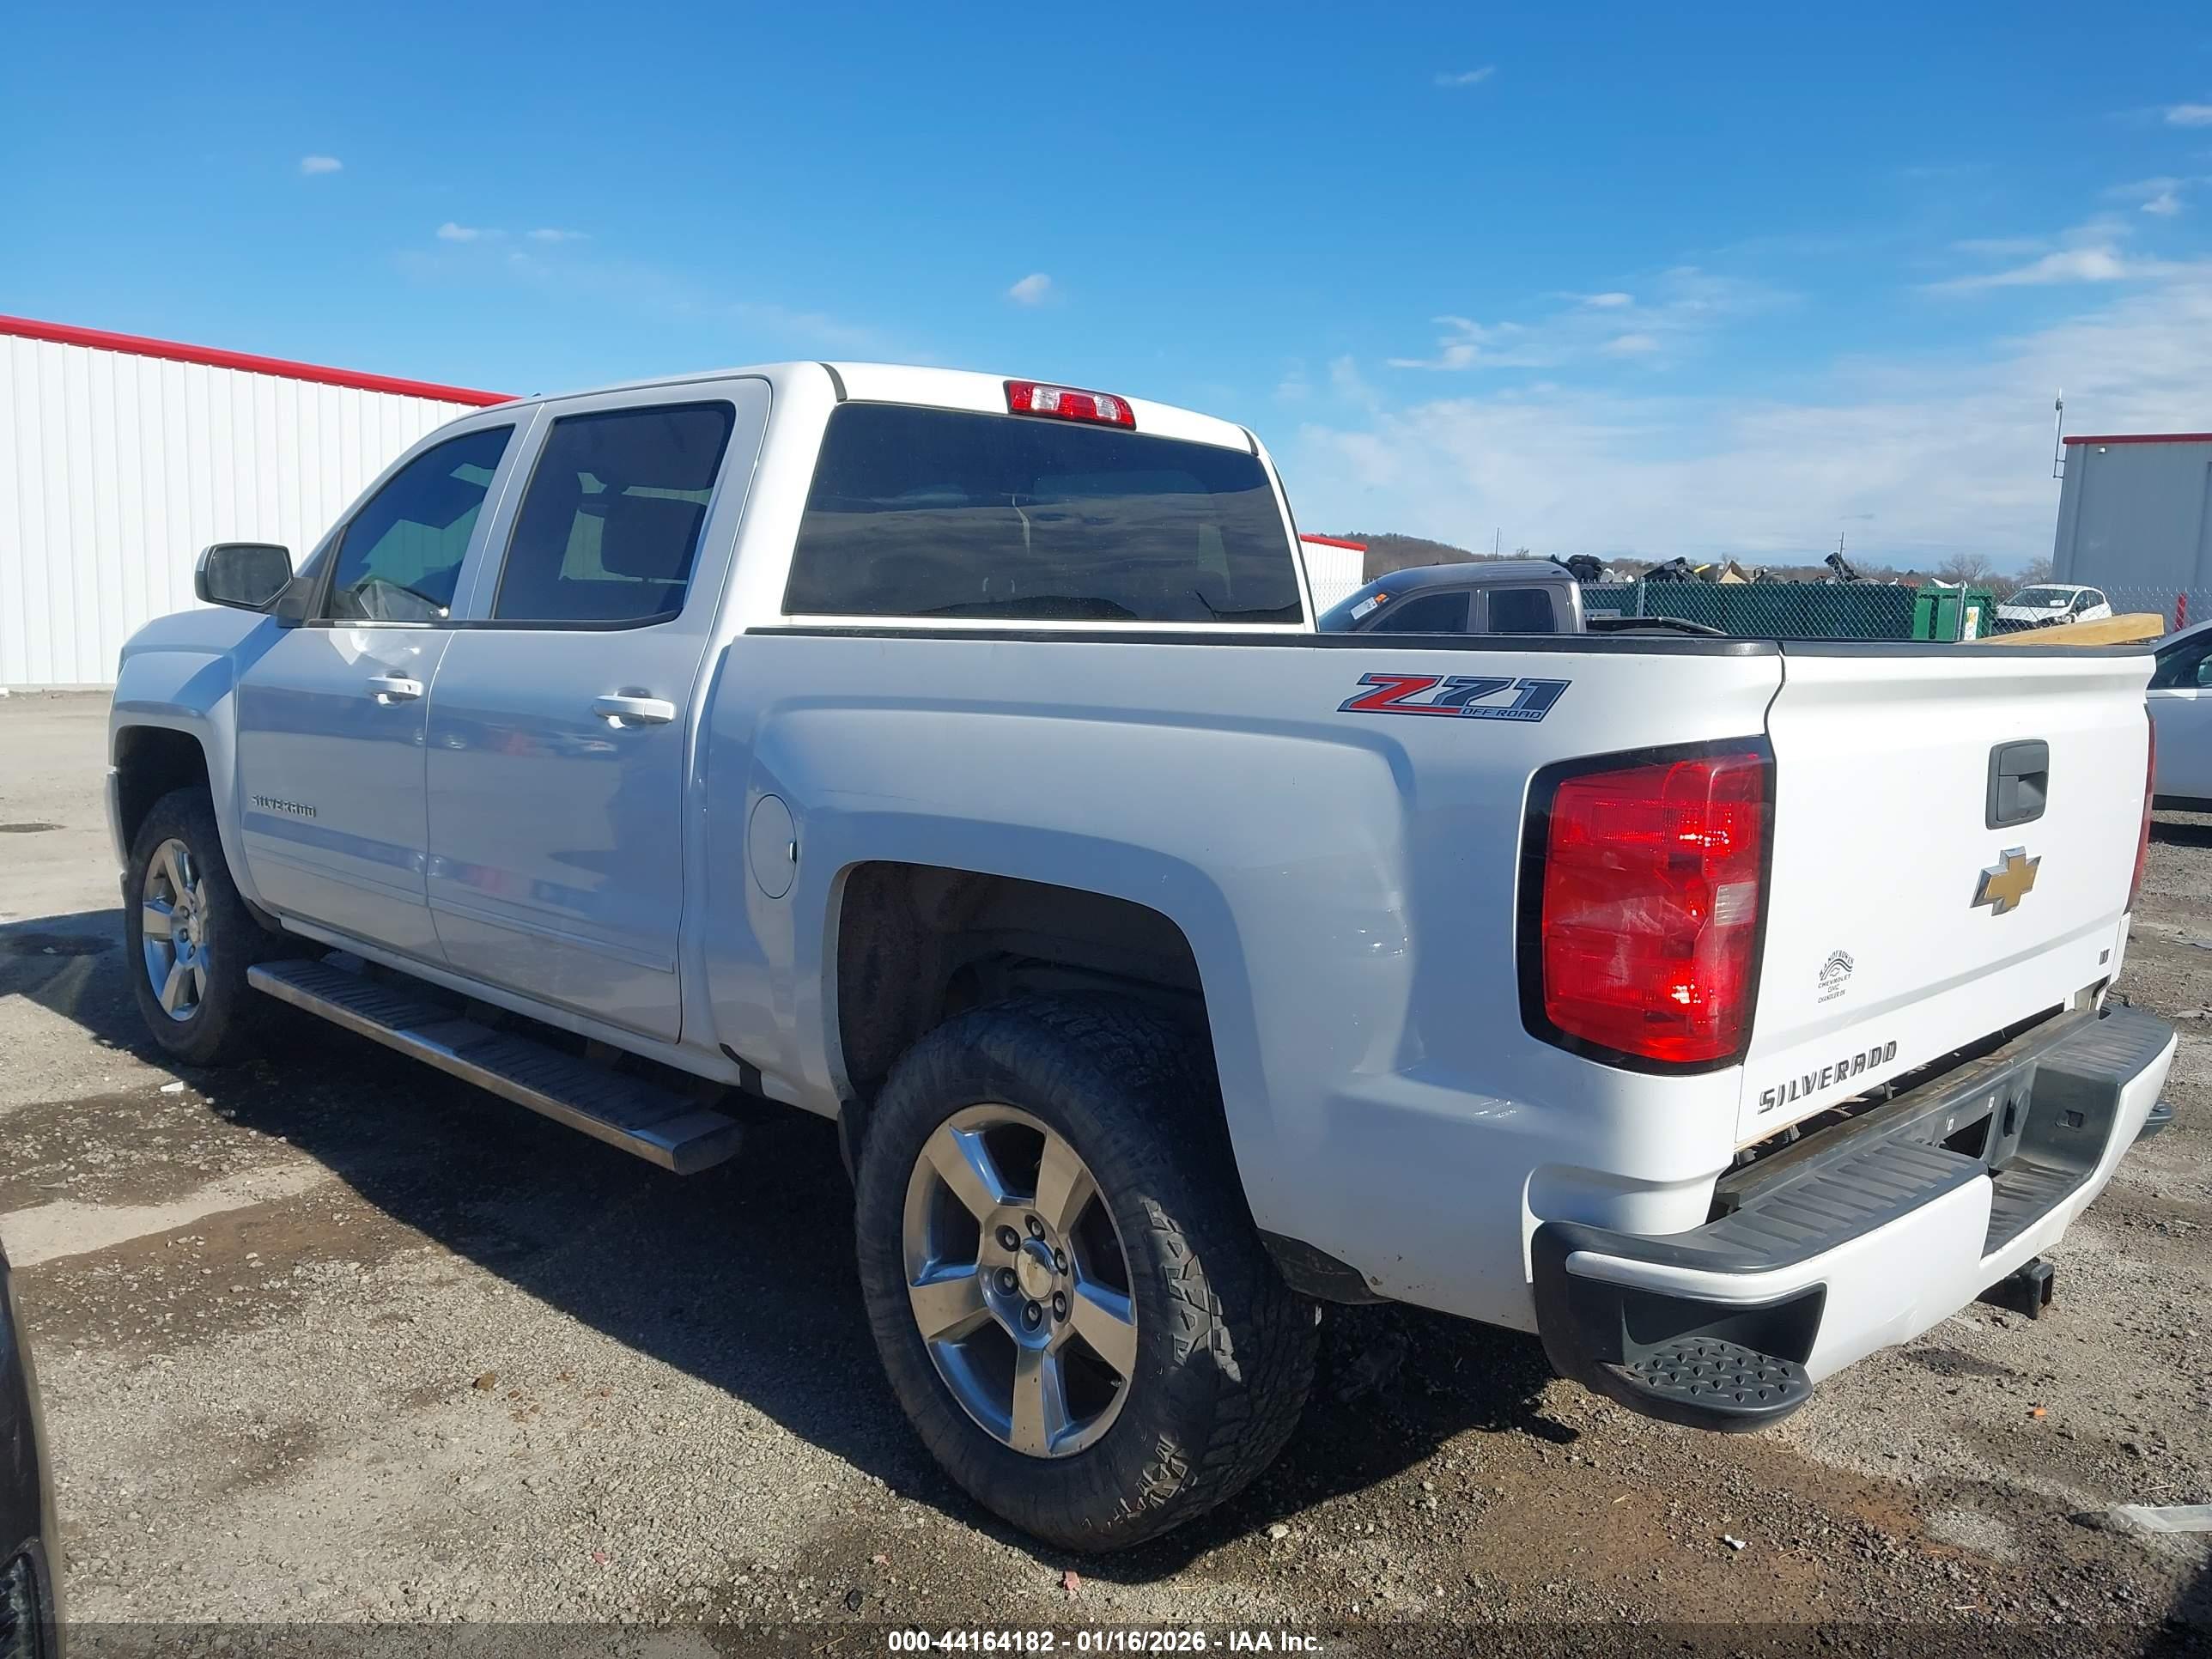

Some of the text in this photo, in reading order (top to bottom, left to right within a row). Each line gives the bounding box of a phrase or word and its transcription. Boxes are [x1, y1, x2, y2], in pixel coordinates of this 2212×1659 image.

[1336, 673, 1573, 719] Z71
[1462, 708, 1542, 719] OFF ROAD
[252, 794, 317, 818] SILVERADO
[1818, 973, 1851, 988] CHEVROLET
[1757, 1040, 1898, 1115] SILVERADO
